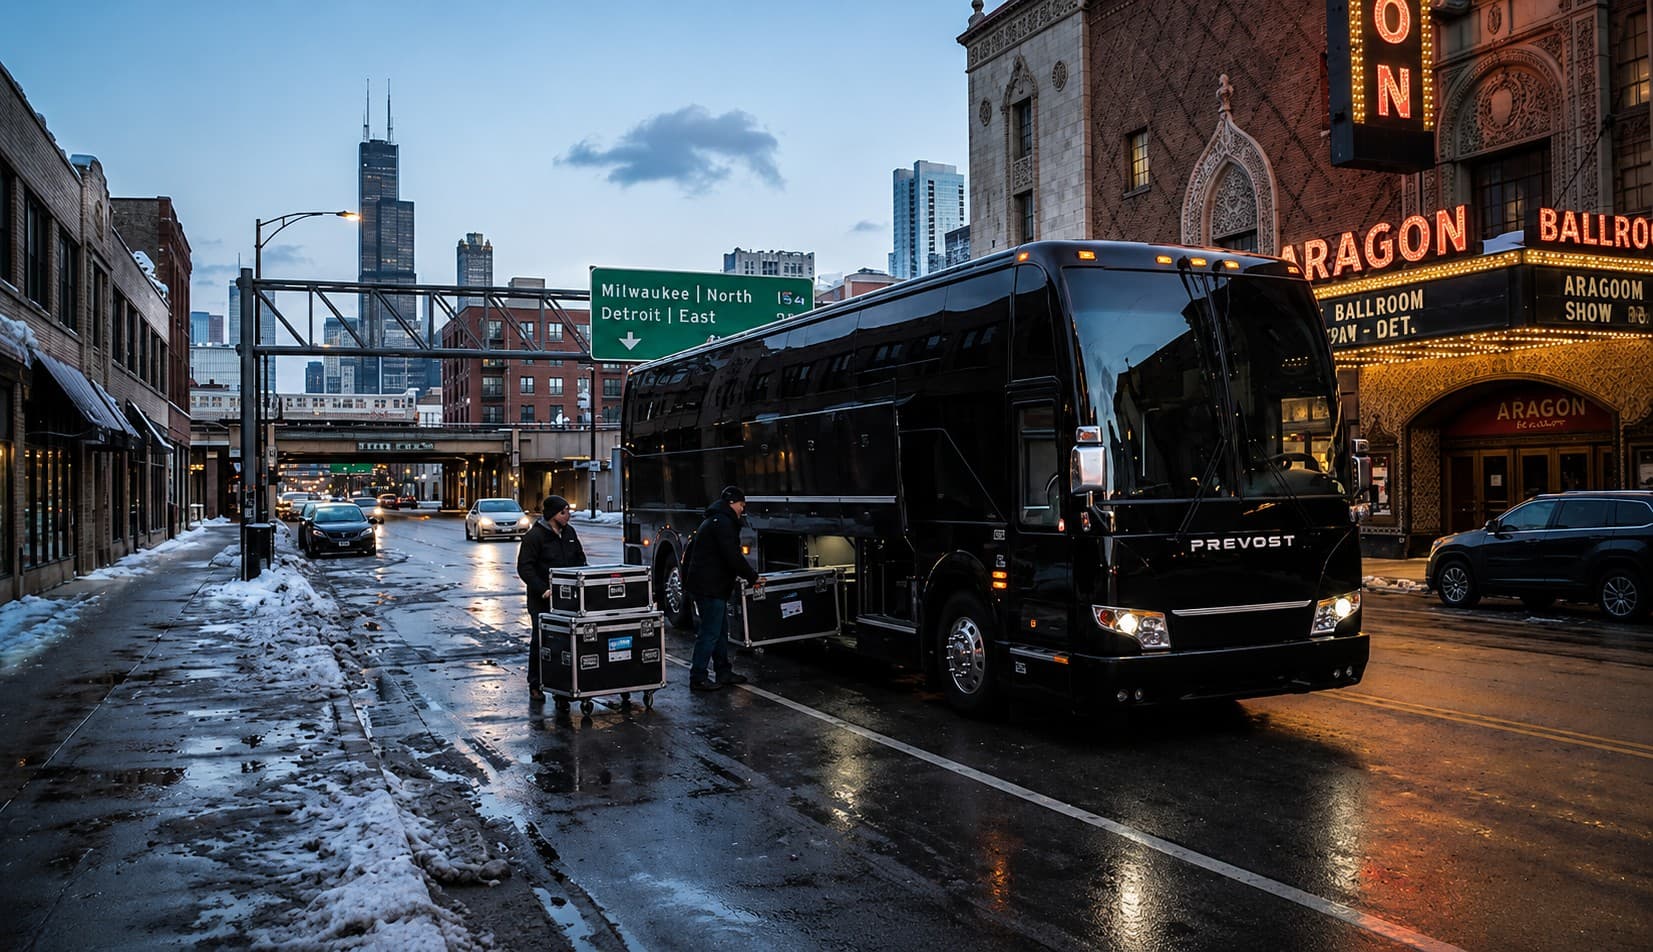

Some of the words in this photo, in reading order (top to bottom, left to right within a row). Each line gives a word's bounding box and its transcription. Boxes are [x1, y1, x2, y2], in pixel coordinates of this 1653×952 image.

[1539, 207, 1653, 250] BALLRO
[601, 283, 690, 301] Milwaukee
[707, 288, 753, 304] North
[1564, 275, 1644, 301] ARAGOOM
[601, 306, 661, 323] Detroit
[679, 309, 716, 324] East
[1335, 288, 1424, 322] BALLROOM
[1565, 300, 1612, 323] SHOW
[1376, 315, 1417, 339] DET.
[1496, 397, 1587, 421] ARAGON
[1190, 534, 1296, 552] PREVOST
